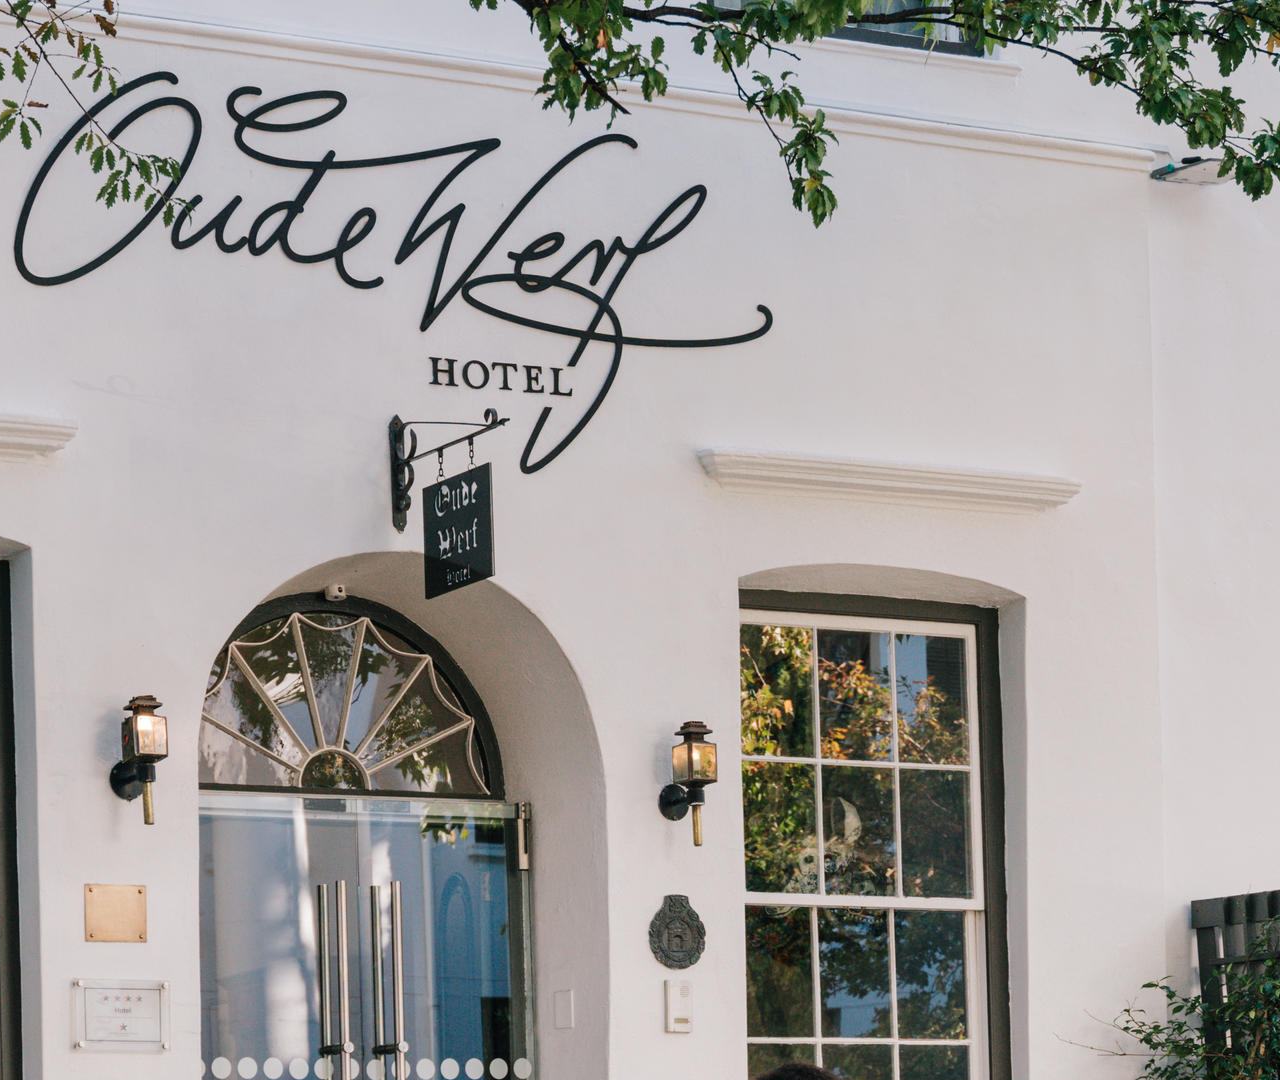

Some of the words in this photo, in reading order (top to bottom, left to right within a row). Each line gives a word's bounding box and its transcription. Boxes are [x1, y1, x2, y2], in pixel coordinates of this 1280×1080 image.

[14, 71, 384, 289] Oude
[395, 134, 773, 474] Werf
[429, 357, 574, 398] HOTEL
[435, 481, 478, 517] Oude
[438, 518, 478, 560] Werf
